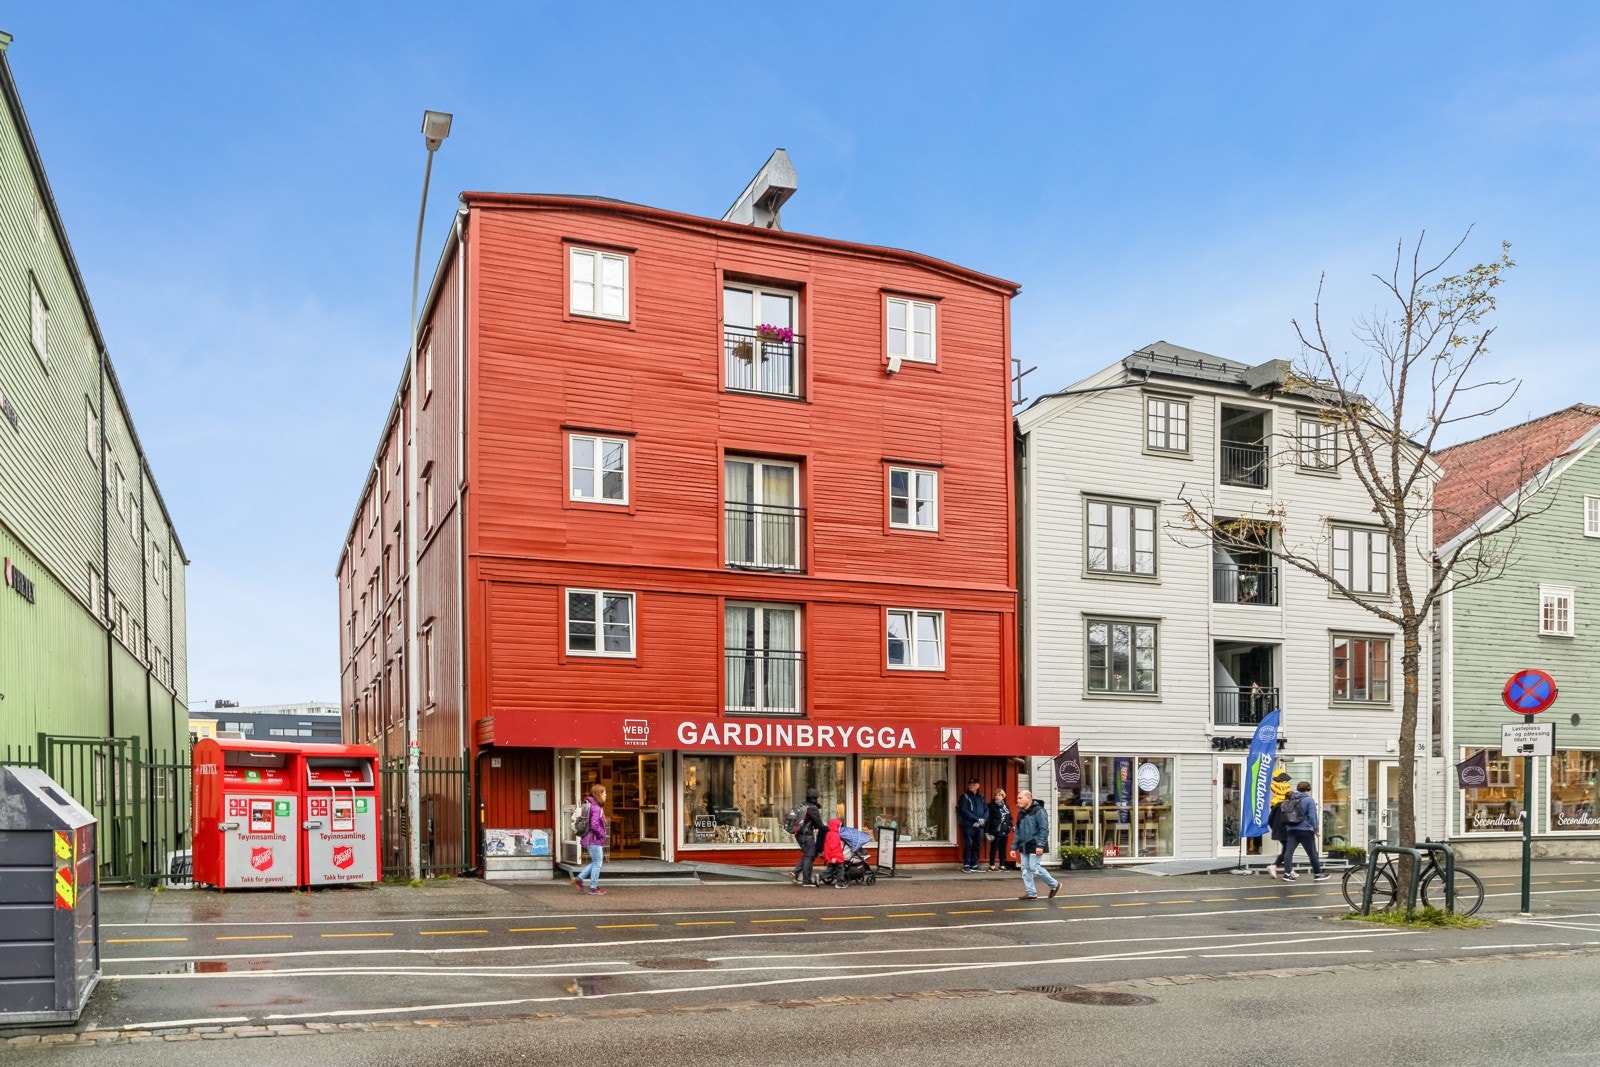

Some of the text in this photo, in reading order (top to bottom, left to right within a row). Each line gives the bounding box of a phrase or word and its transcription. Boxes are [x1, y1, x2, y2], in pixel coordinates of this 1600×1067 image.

[623, 726, 650, 734] WEBO
[677, 722, 916, 749] GARDINBRYGGA
[1418, 743, 1425, 751] 36
[1254, 753, 1271, 827] Blundstone
[694, 820, 717, 828] WEBO
[1473, 813, 1521, 827] Secondhand
[238, 833, 287, 842] Tøyinnsamling
[320, 833, 366, 841] Tøyinnsamling
[1106, 849, 1117, 857] HH
[346, 873, 364, 881] gaven!
